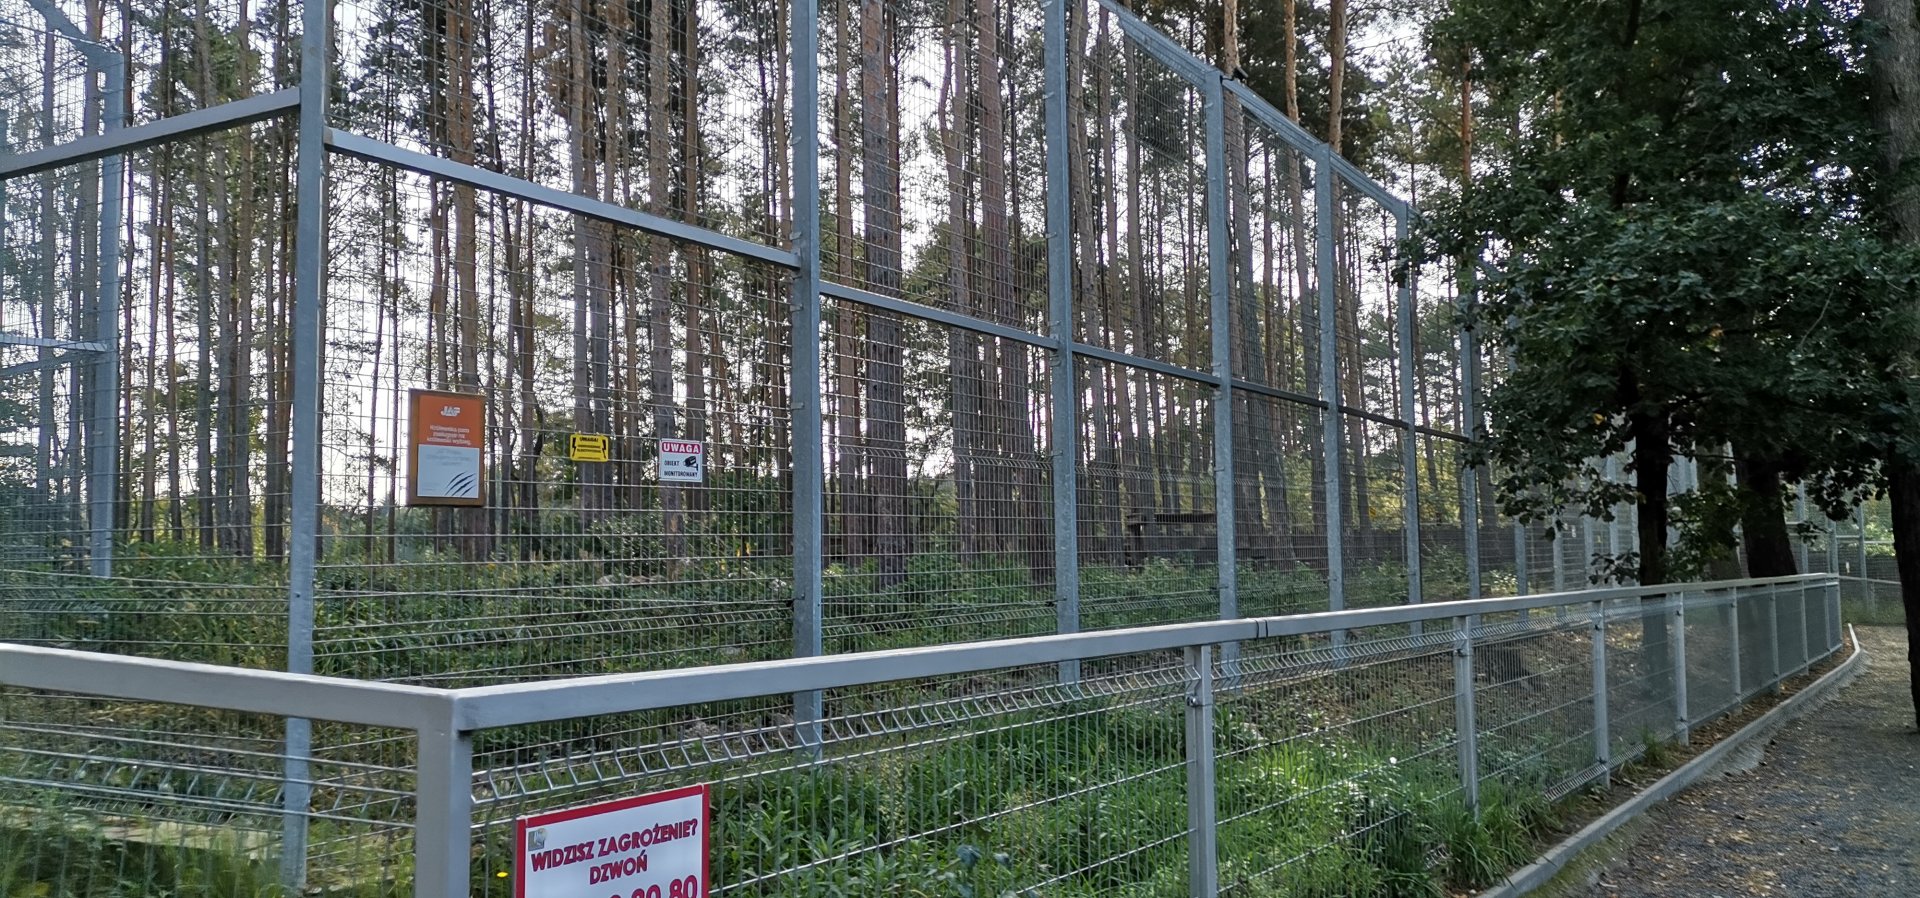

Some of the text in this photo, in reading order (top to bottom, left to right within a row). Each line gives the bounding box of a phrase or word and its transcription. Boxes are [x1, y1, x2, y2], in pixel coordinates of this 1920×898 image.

[663, 443, 700, 454] UWAGA
[531, 818, 698, 872] WIDZISZ ZAGROŻENIE?
[590, 849, 648, 885] DZWOŃ
